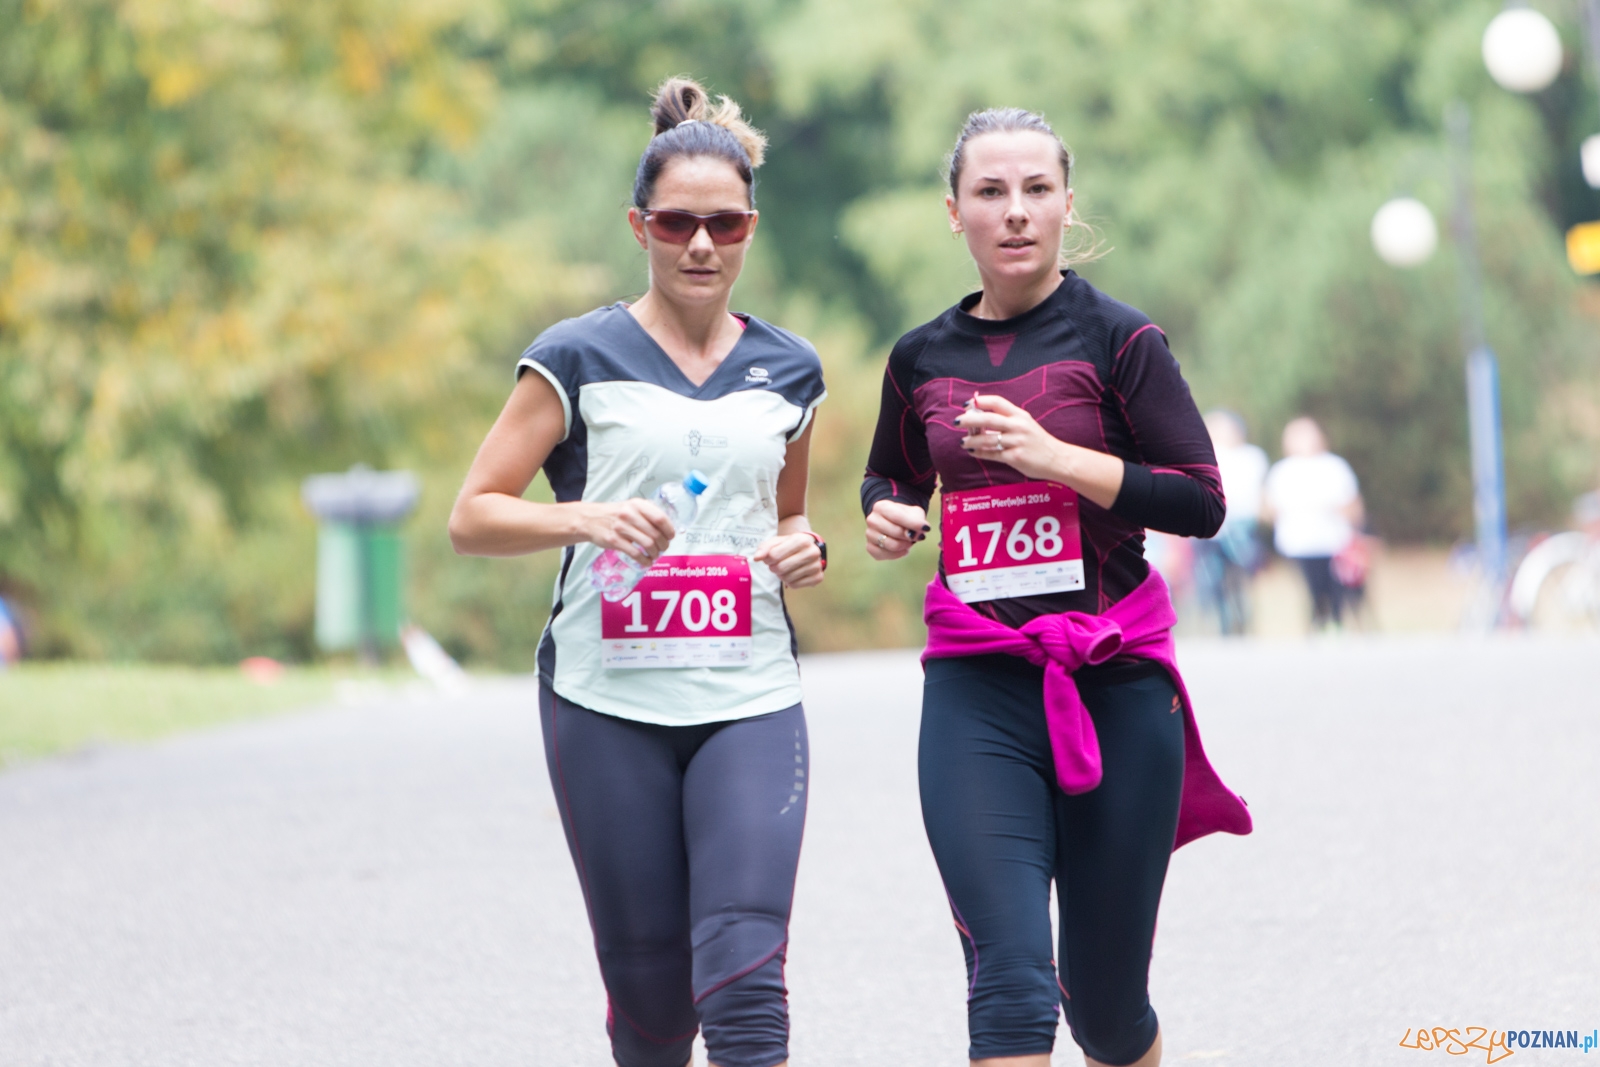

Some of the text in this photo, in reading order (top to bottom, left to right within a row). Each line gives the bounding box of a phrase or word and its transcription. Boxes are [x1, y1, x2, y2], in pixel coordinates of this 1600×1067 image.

[962, 501, 990, 513] Zawsze
[991, 495, 1027, 509] Pier(w)si
[1027, 493, 1051, 504] 2016
[954, 515, 1064, 568] 1768
[706, 566, 729, 577] 2016
[621, 589, 738, 633] 1708
